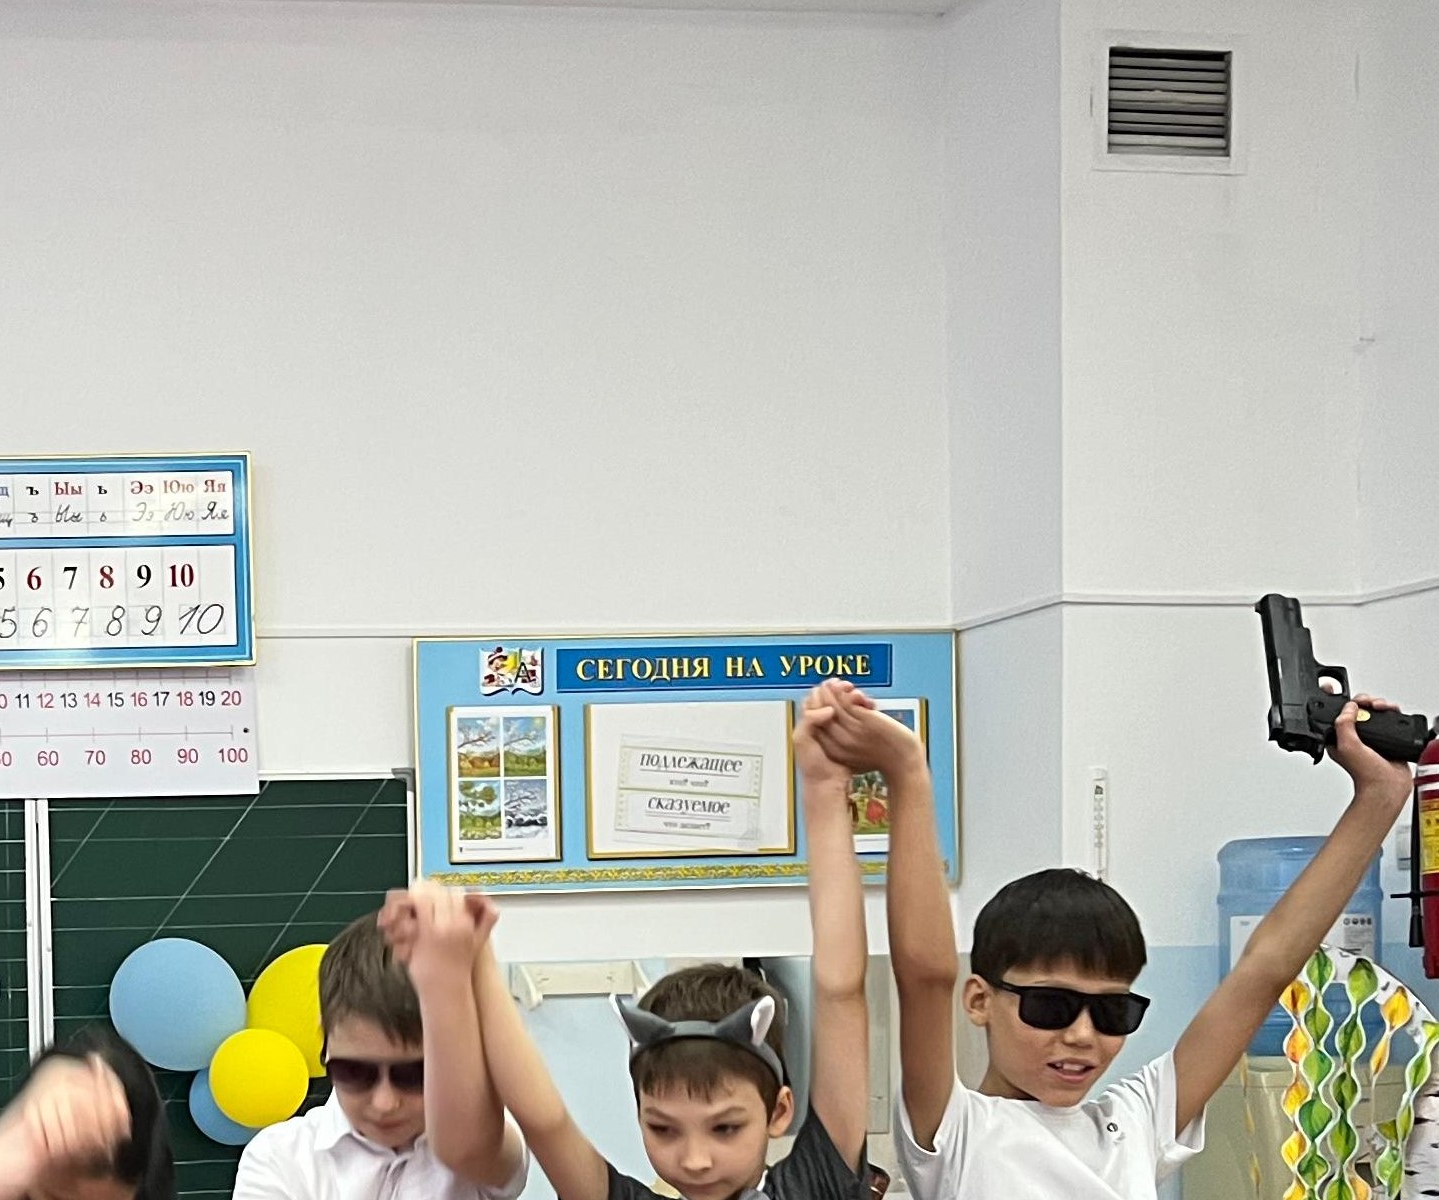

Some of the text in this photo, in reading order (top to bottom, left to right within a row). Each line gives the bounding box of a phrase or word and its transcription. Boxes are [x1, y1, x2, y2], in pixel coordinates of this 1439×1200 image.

[26, 487, 39, 495] ъ
[55, 482, 81, 495] Ыы
[98, 486, 107, 494] ь
[131, 481, 153, 494] Ээ
[164, 480, 194, 493] Юю
[205, 480, 225, 492] Яя
[27, 567, 41, 590] 6
[64, 567, 77, 589] 7
[100, 566, 114, 588] 8
[137, 565, 151, 588] 9
[170, 564, 194, 587] 10
[32, 607, 52, 637] 6
[72, 607, 89, 636] 7
[107, 605, 125, 636] 8
[141, 606, 162, 636] 9
[179, 604, 224, 634] 10
[576, 654, 871, 682] СЕГОДНЯ НА УРОКЕ
[15, 694, 29, 708] 11
[37, 693, 54, 708] 12
[60, 693, 77, 708] 13
[84, 693, 100, 707] 14
[107, 692, 124, 707] 15
[131, 692, 147, 706] 16
[153, 692, 169, 706] 17
[177, 691, 193, 706] 18
[199, 691, 215, 706] 19
[221, 691, 241, 705] 20
[38, 751, 58, 766] 60
[85, 750, 105, 765] 70
[131, 750, 151, 764] 80
[178, 749, 198, 764] 90
[219, 748, 248, 763] 100
[648, 797, 730, 814] сказуемое
